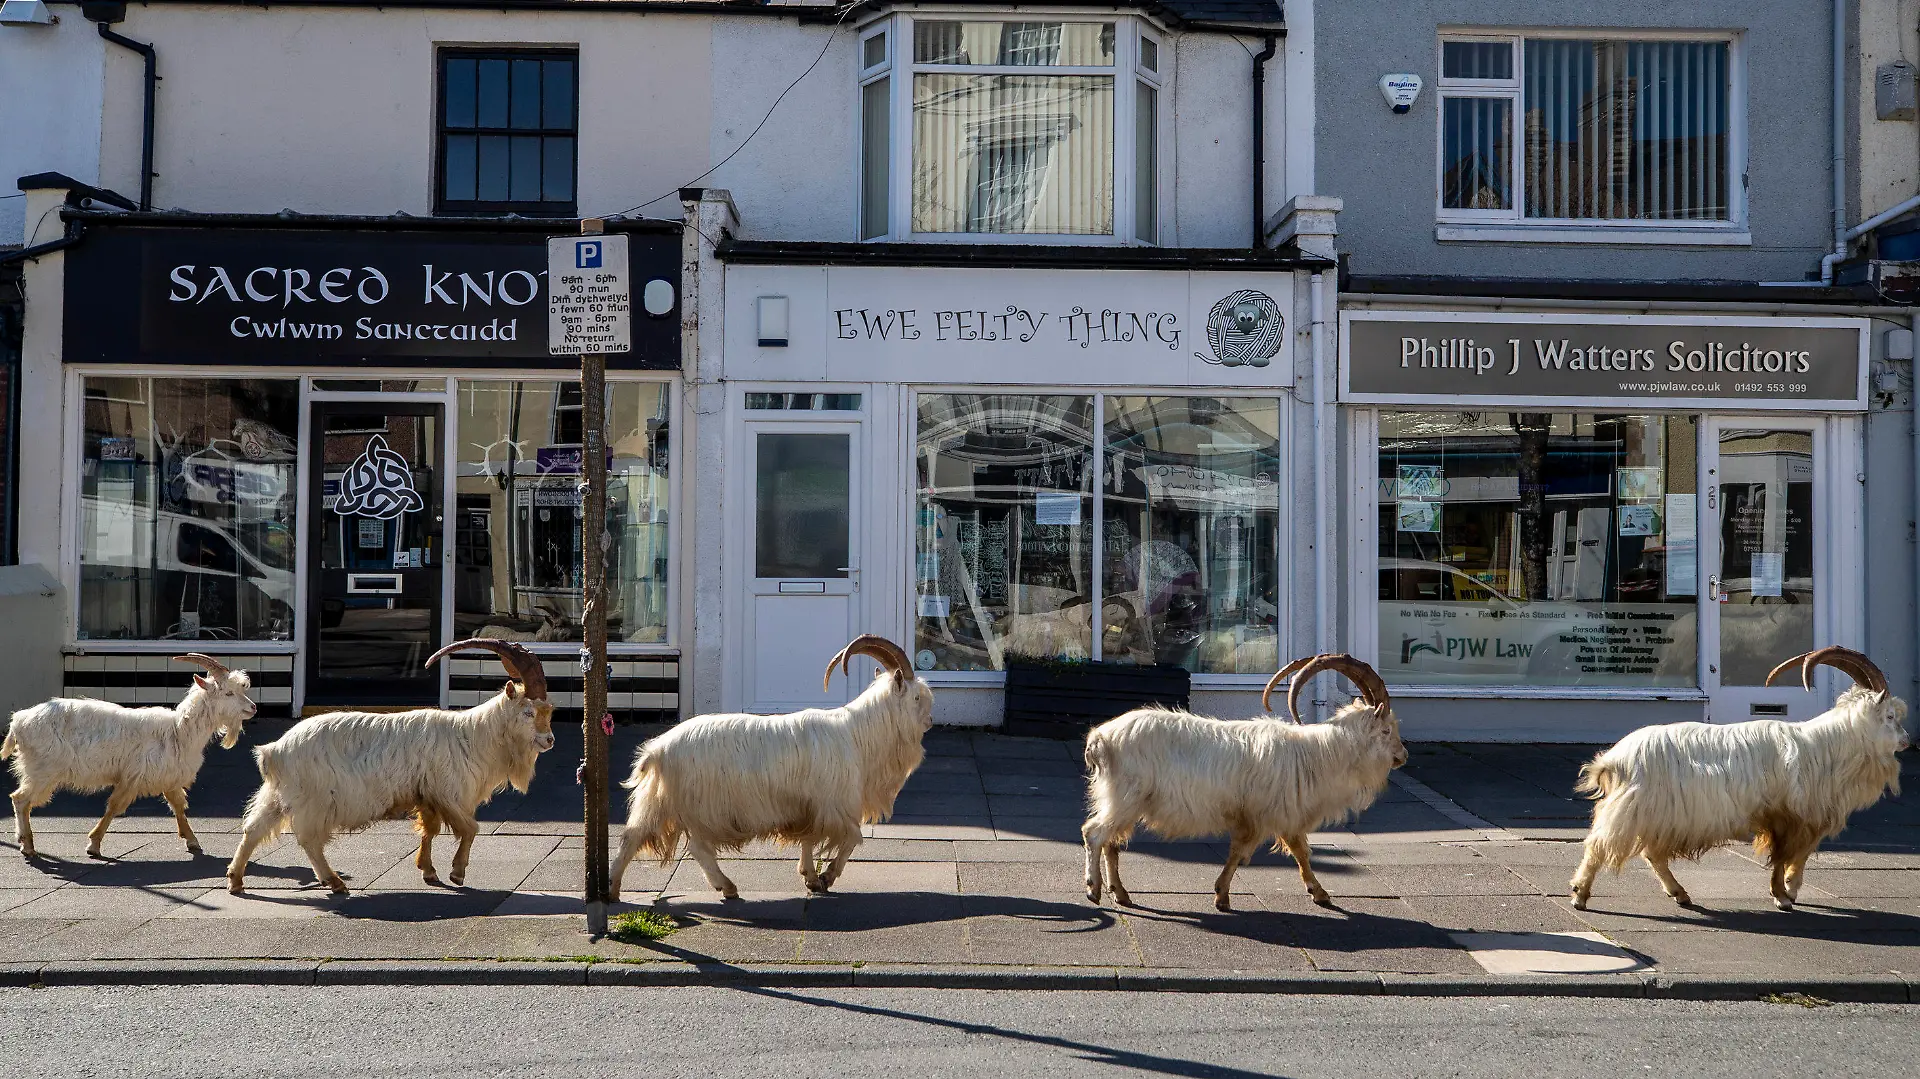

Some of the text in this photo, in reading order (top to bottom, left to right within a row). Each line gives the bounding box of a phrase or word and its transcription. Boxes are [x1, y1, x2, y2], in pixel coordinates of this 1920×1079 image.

[581, 243, 597, 267] P
[561, 275, 583, 284] 9am
[595, 274, 617, 284] 6pm
[422, 264, 548, 311] KNO
[569, 285, 610, 294] 90 mun
[551, 293, 629, 304] Dim dychwelyd
[561, 304, 585, 314] fewn
[589, 303, 603, 312] 60
[607, 303, 629, 312] mun
[560, 315, 583, 324] 9am
[595, 314, 617, 324] 6pm
[230, 316, 517, 341] Cwlwm Sanctaidd
[568, 324, 611, 333] 90 mins
[834, 305, 1182, 350] EWE FELTY THING
[564, 333, 615, 343] No return
[550, 343, 629, 354] within 60 mins
[1400, 337, 1811, 375] Phillip J Watters Solicitors
[1618, 381, 1807, 396] www.pjwlaw.co.uk 01492 553 999
[1401, 609, 1411, 617] No
[1414, 609, 1428, 617] Win
[1430, 609, 1441, 617] No
[1443, 610, 1457, 618] Fee
[1478, 610, 1498, 618] Fixed
[1519, 611, 1530, 619] As
[1532, 611, 1566, 619] Standard
[1559, 635, 1588, 643] Medical
[1446, 637, 1534, 660] PJW Law
[1621, 646, 1654, 655] Attorney
[1575, 655, 1596, 663] Small
[1633, 655, 1659, 664] Advice
